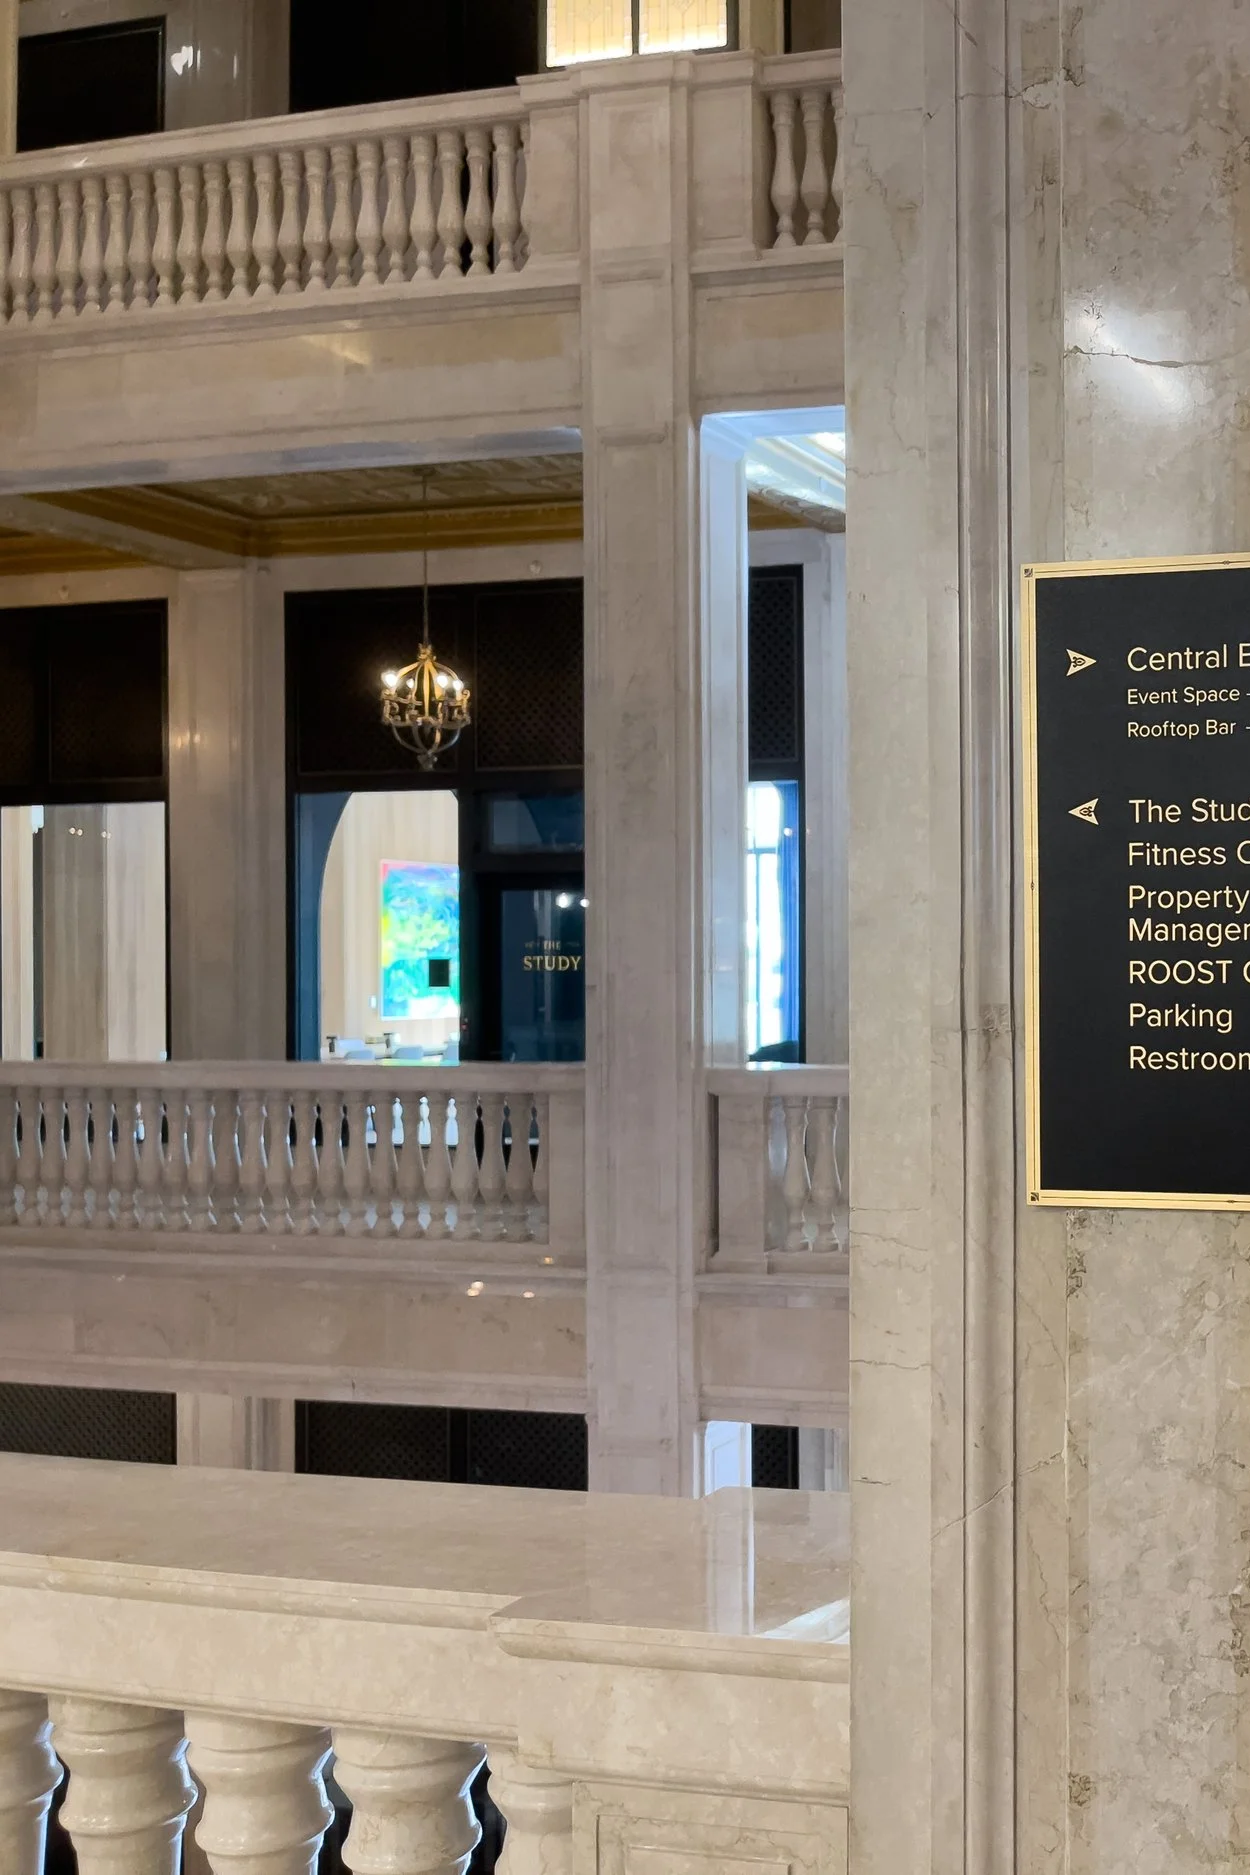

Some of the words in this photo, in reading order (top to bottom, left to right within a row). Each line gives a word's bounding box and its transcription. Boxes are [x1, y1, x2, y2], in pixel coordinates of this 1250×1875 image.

[1127, 644, 1228, 672] Central
[1127, 688, 1179, 705] Event
[1183, 686, 1241, 706] Space
[1127, 720, 1200, 740] Rooftop
[1205, 718, 1237, 736] Bar
[1128, 799, 1182, 824] The
[1128, 841, 1227, 867] Fitness
[1128, 884, 1250, 915] Property
[523, 955, 581, 971] STUDY
[1129, 959, 1233, 985] ROOST
[1129, 1002, 1233, 1034] Parking
